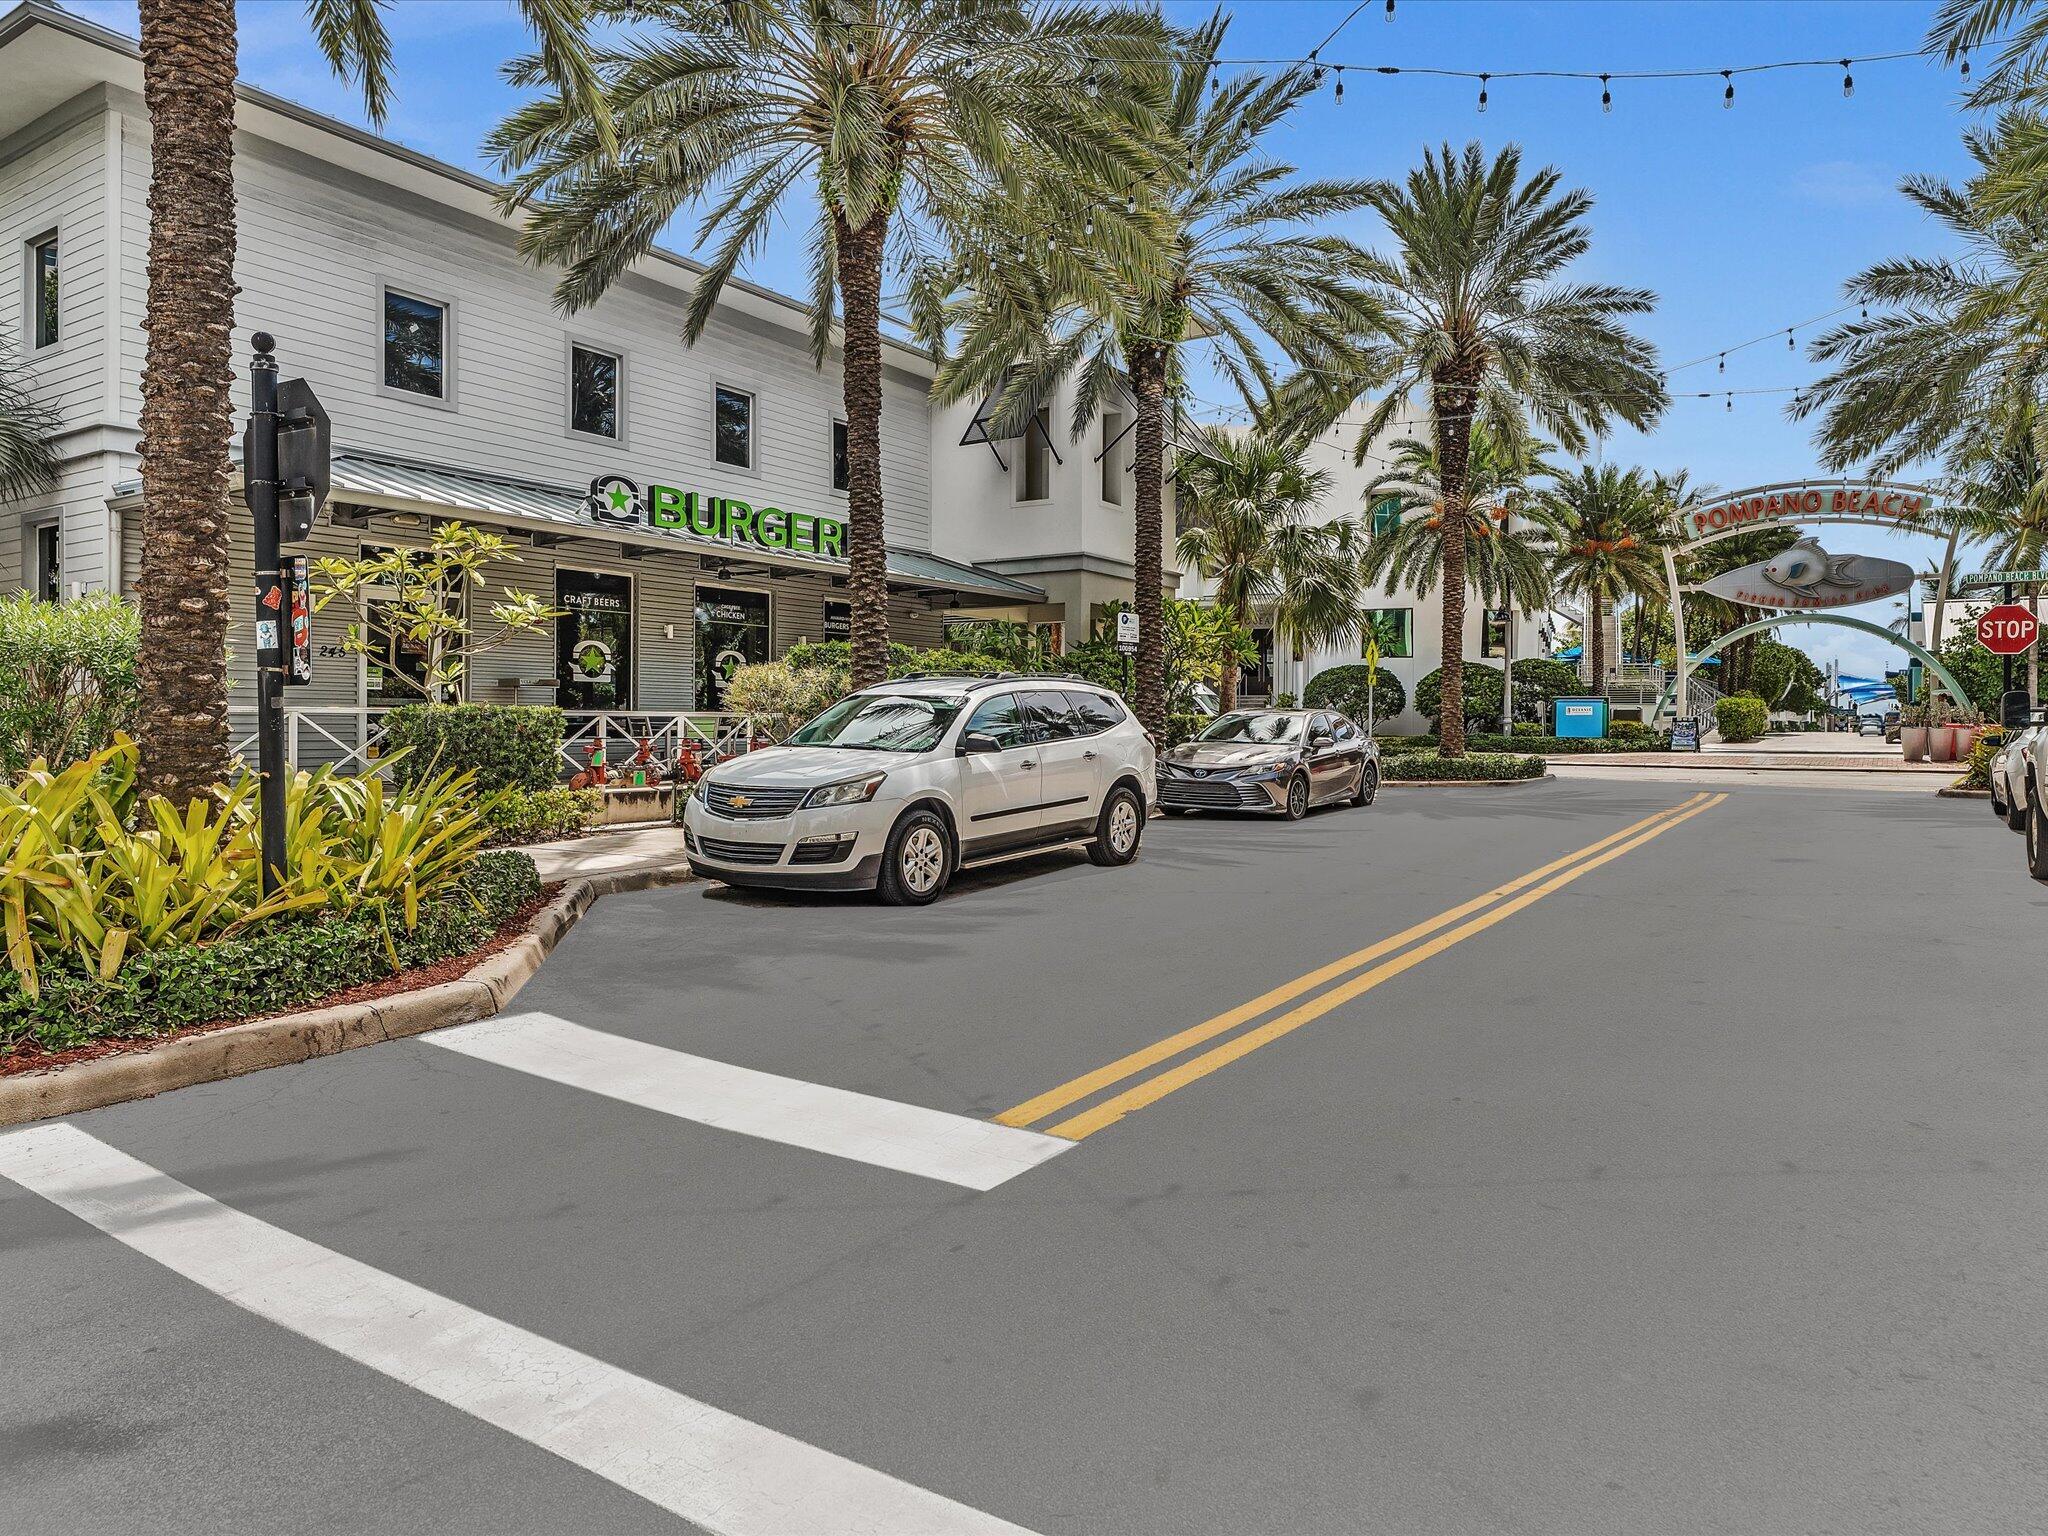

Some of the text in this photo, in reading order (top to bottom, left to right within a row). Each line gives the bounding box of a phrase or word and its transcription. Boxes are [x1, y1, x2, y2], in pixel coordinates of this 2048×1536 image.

[1693, 490, 1923, 534] POMPANO BEACH
[1969, 573, 2003, 582] POMPANO
[2005, 572, 2029, 581] BEACH
[563, 594, 620, 608] CRAFT BEERS
[716, 610, 745, 620] CHICKEN
[824, 621, 850, 631] BURGERS
[1981, 620, 2034, 639] STOP
